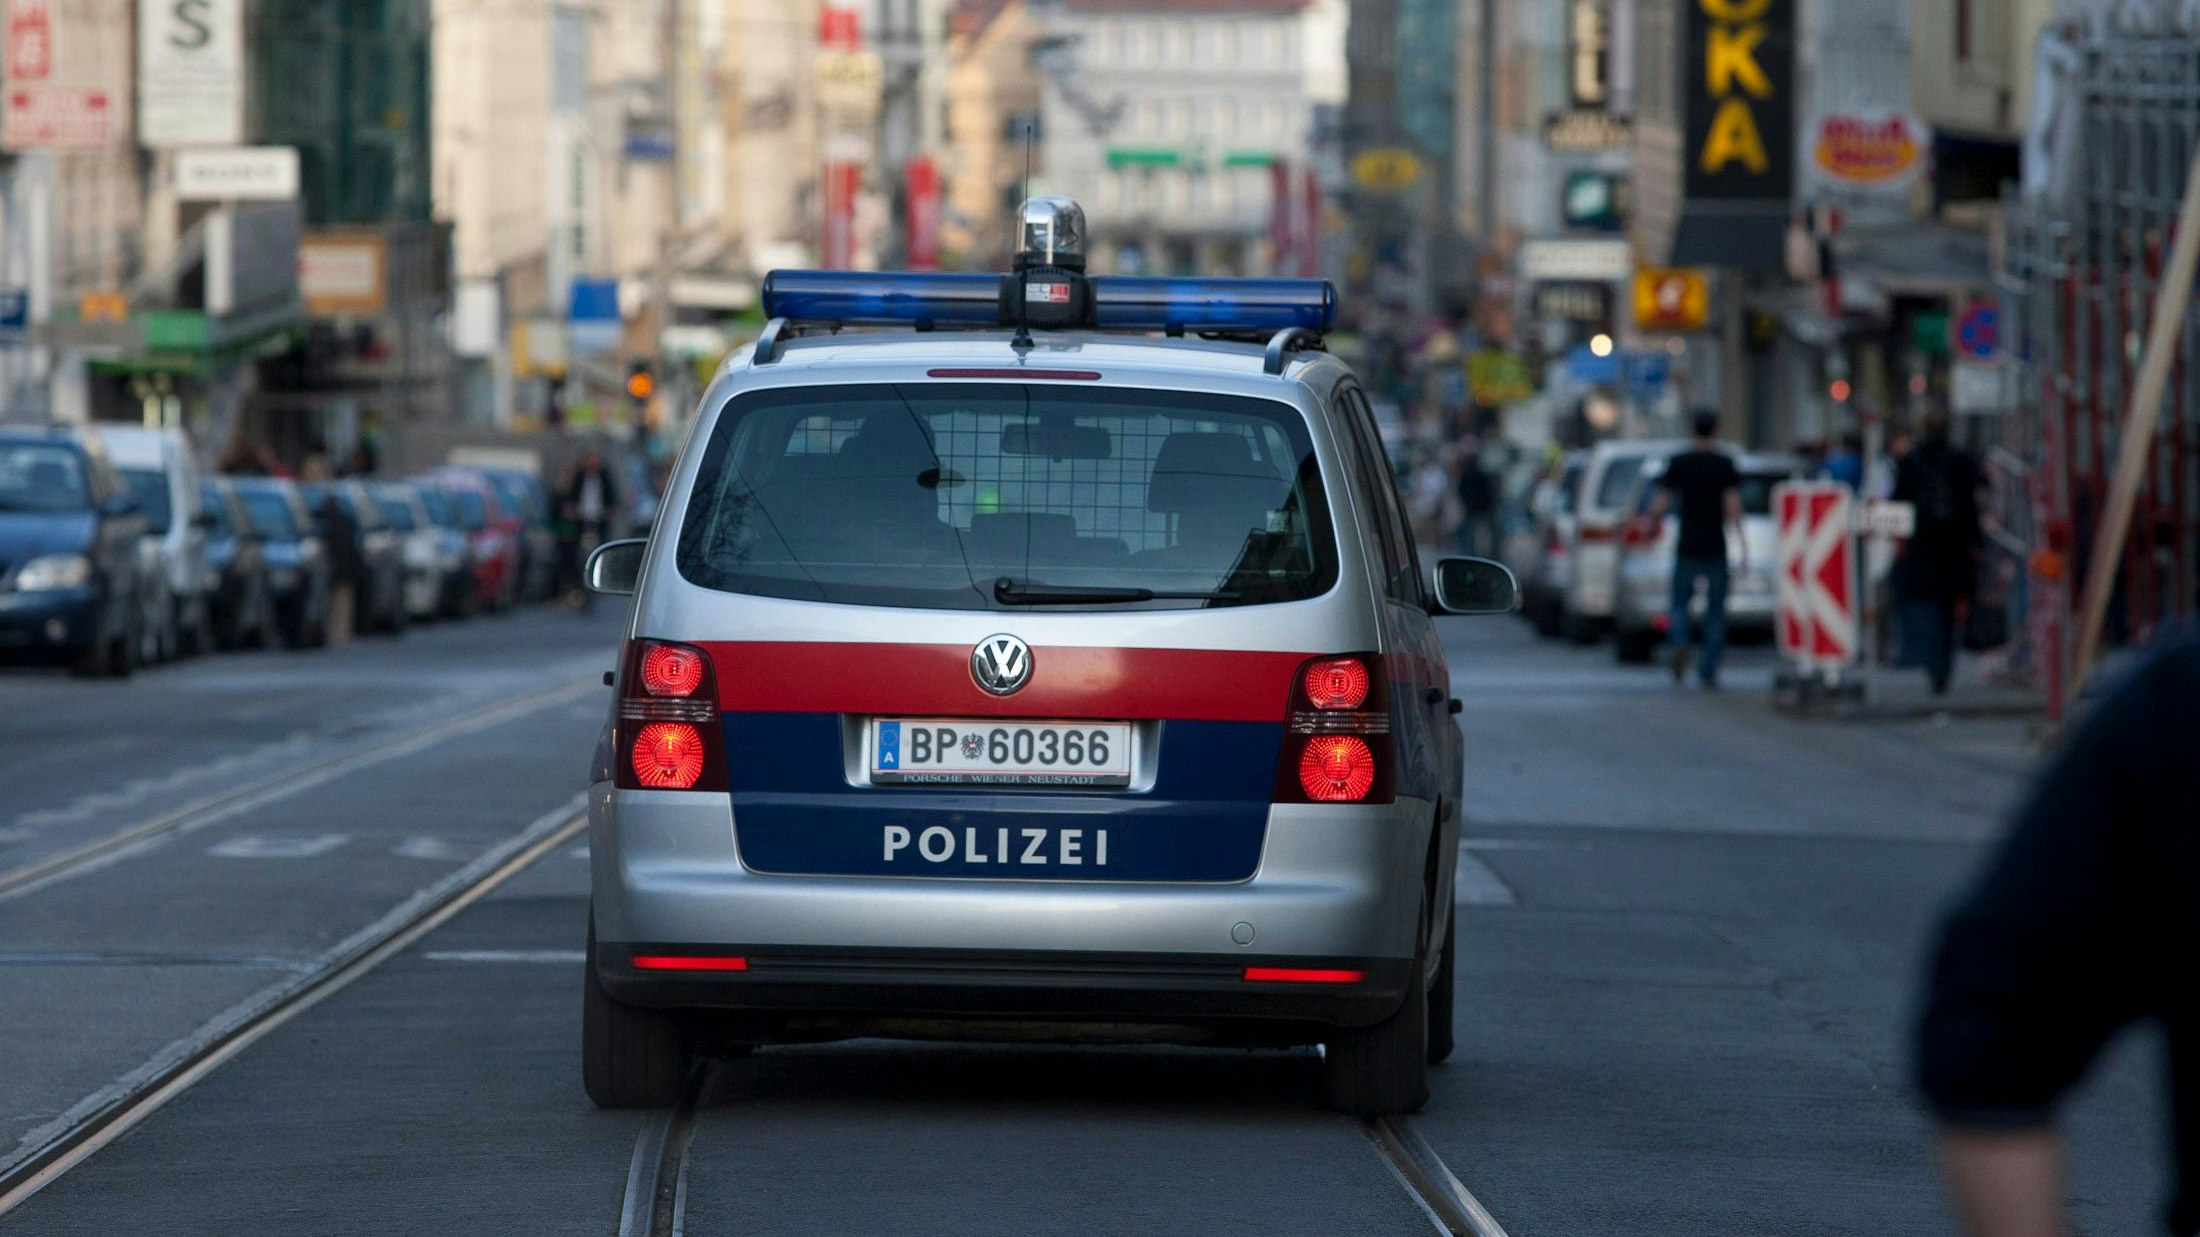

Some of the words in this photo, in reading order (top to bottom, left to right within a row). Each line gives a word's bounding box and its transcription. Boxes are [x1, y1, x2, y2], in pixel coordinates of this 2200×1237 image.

[883, 752, 894, 763] A
[911, 728, 958, 763] BP
[989, 728, 1109, 766] 60366
[903, 774, 963, 783] PORSCHE
[971, 775, 1020, 783] WIENER
[1028, 776, 1097, 785] NEUSTADT
[883, 825, 1108, 866] POLIZEI
